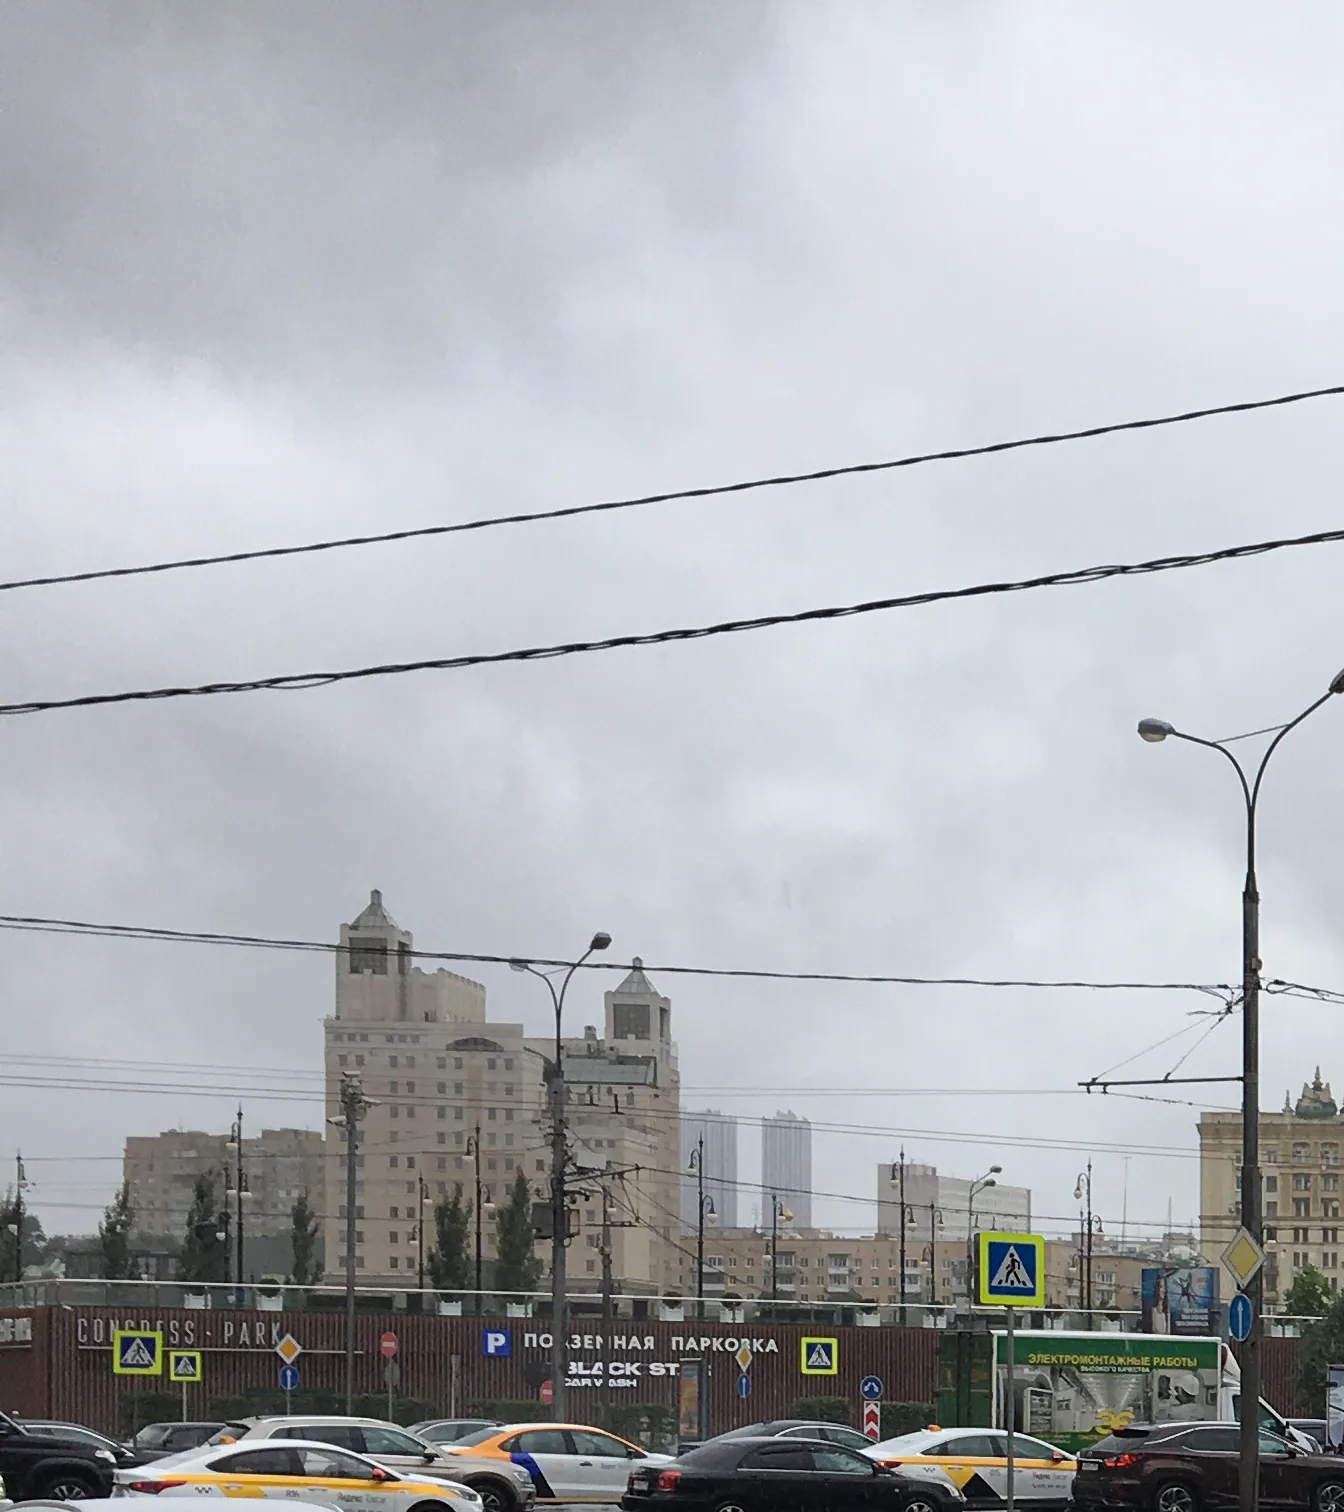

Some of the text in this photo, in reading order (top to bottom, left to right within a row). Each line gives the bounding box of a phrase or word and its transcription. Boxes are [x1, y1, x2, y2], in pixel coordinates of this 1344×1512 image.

[223, 1321, 281, 1345] PARK
[1028, 1354, 1198, 1367] ЭЛЕКТРОМОНТАЖНЫЕ РАБОТЫ
